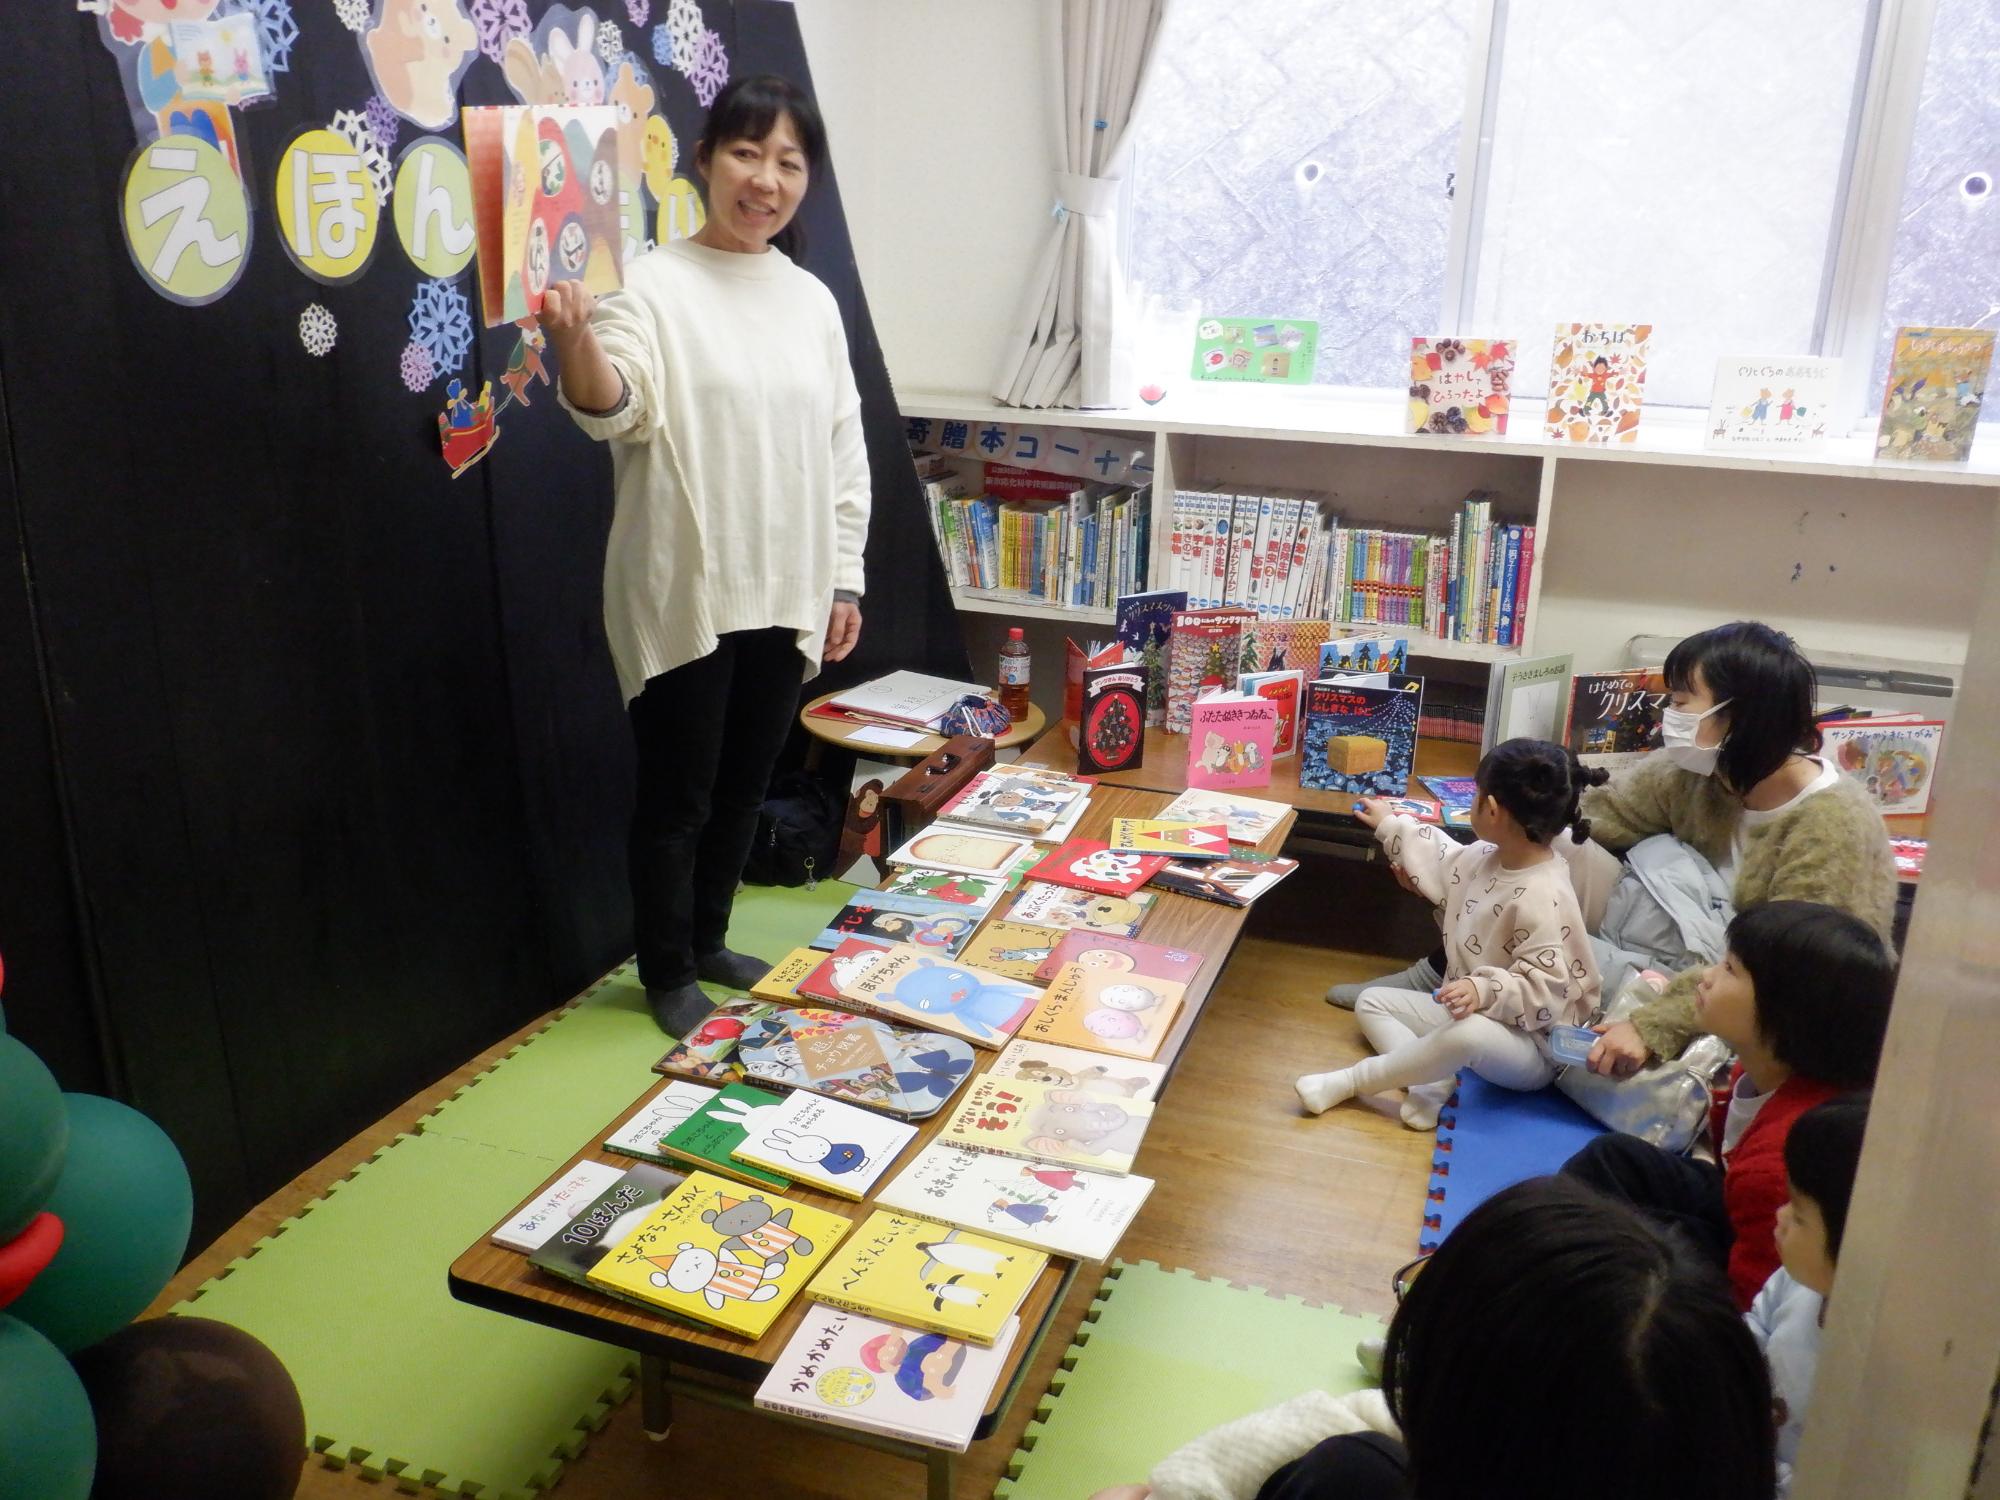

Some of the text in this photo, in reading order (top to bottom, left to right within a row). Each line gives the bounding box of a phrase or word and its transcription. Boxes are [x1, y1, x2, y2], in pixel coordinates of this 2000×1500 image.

[1582, 329, 1626, 345] おちば
[906, 417, 1154, 476] 寄贈本コーナー
[1312, 692, 1366, 705] クリスマスの
[1588, 678, 1634, 695] はじめての
[1597, 690, 1667, 720] クリスマ
[857, 954, 911, 993] ほげちゃん
[562, 1184, 645, 1246] 10ぱんだ
[615, 1184, 707, 1265] さよなら さんかく
[840, 1215, 909, 1292] ぺんぎんたいそ
[788, 1310, 850, 1396] かめかめたい
